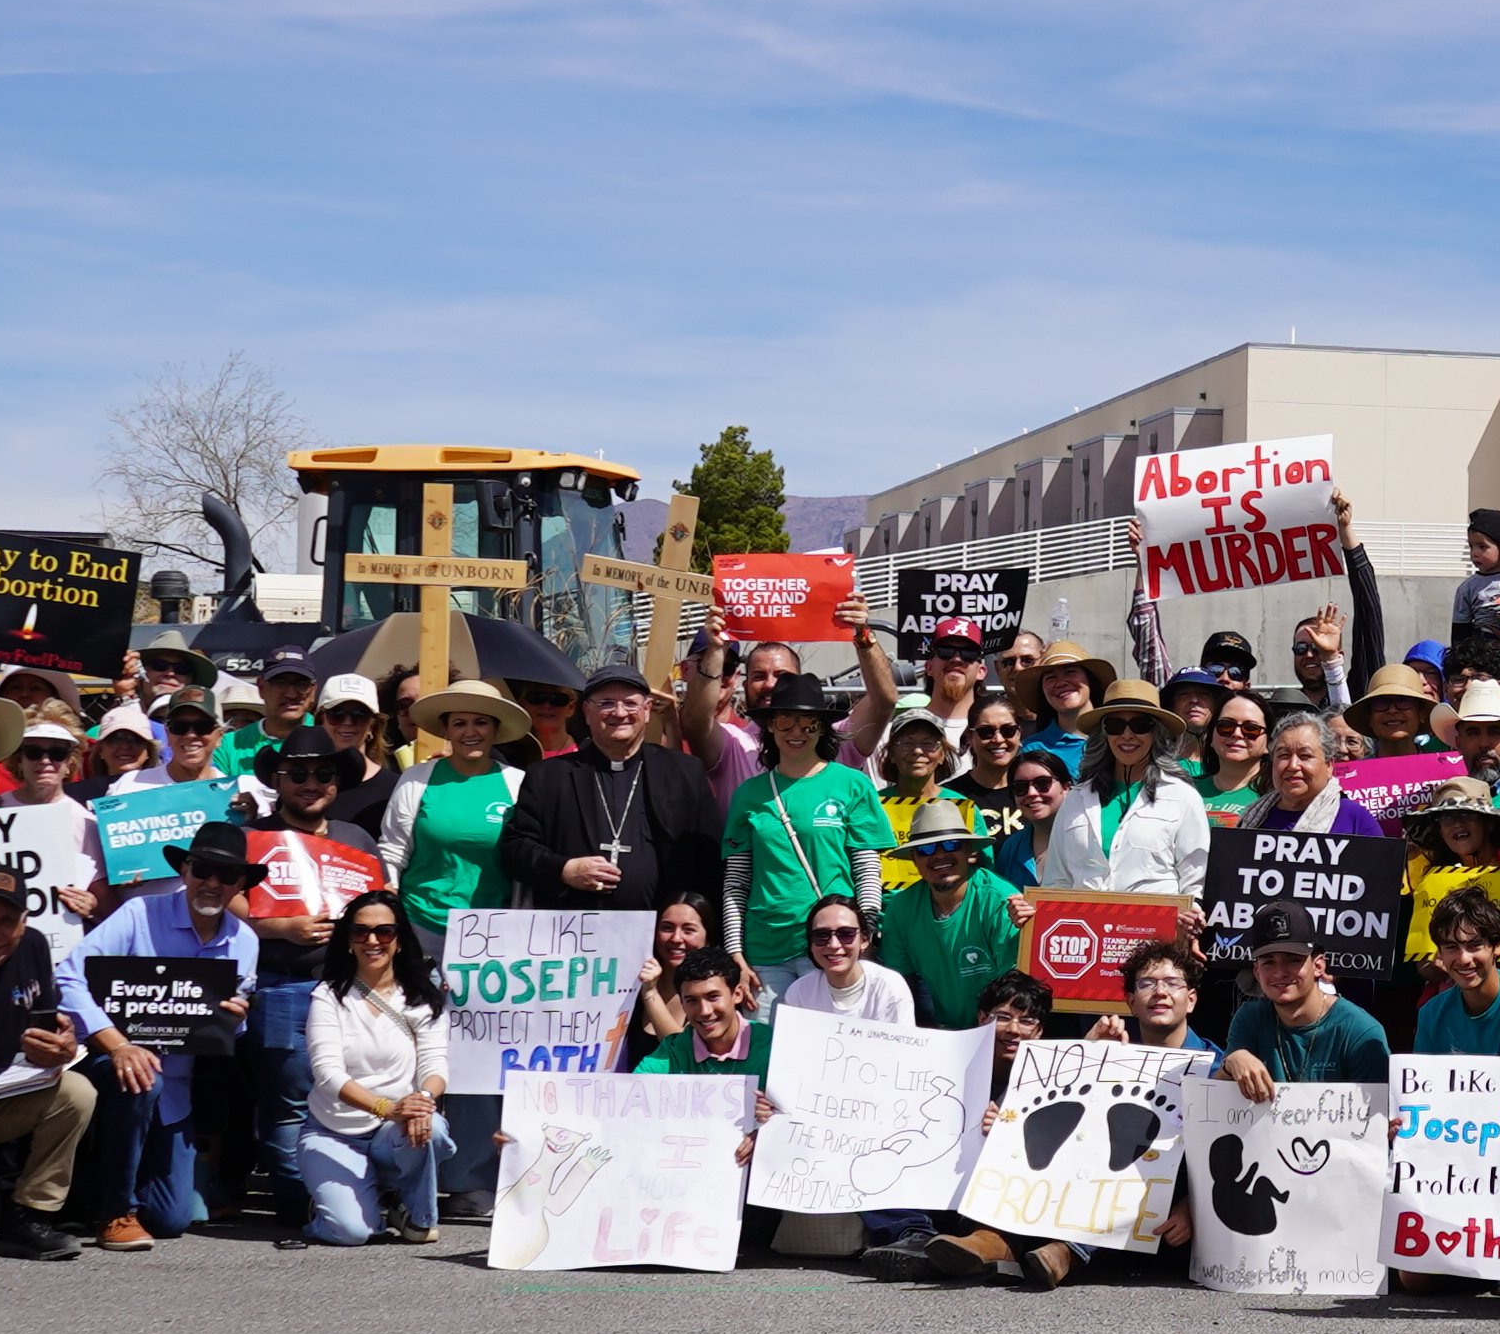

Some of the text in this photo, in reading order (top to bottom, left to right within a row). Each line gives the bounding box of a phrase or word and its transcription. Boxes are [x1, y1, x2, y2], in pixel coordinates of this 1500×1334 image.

[1138, 444, 1330, 501] Abortion
[1201, 490, 1267, 536] IS
[29, 548, 58, 572] to
[67, 551, 129, 583] End
[371, 563, 515, 580] MEMORY UNBORN
[1147, 523, 1344, 599] MURDER
[605, 568, 671, 589] MEMORY of the
[722, 578, 811, 592] TOGETHER,
[935, 573, 1000, 592] PRAY
[724, 592, 806, 604] WE STAND
[921, 593, 1009, 613] TO END
[724, 605, 796, 617] FOR LIFE.
[225, 658, 265, 672] 524
[1391, 785, 1402, 796] &
[106, 811, 206, 836] PRAYING TO
[110, 831, 145, 849] END
[1253, 834, 1350, 866] PRAY
[1238, 868, 1366, 901] TO END
[458, 912, 600, 958] BE LIKE
[1049, 935, 1090, 955] STOP
[111, 980, 203, 1001] Every life
[105, 998, 213, 1018] is precious.
[450, 1010, 601, 1044] PROTECT THEM
[835, 1022, 862, 1037] I AM
[1401, 1068, 1433, 1095] Be
[523, 1079, 746, 1118] NO THANKS
[1227, 1086, 1372, 1140] am fearfully
[789, 1121, 819, 1149] THE
[791, 1157, 825, 1176] OF
[1389, 1161, 1499, 1196] Protect
[761, 1170, 868, 1210] HAPPINESS
[1318, 1253, 1374, 1285] made
